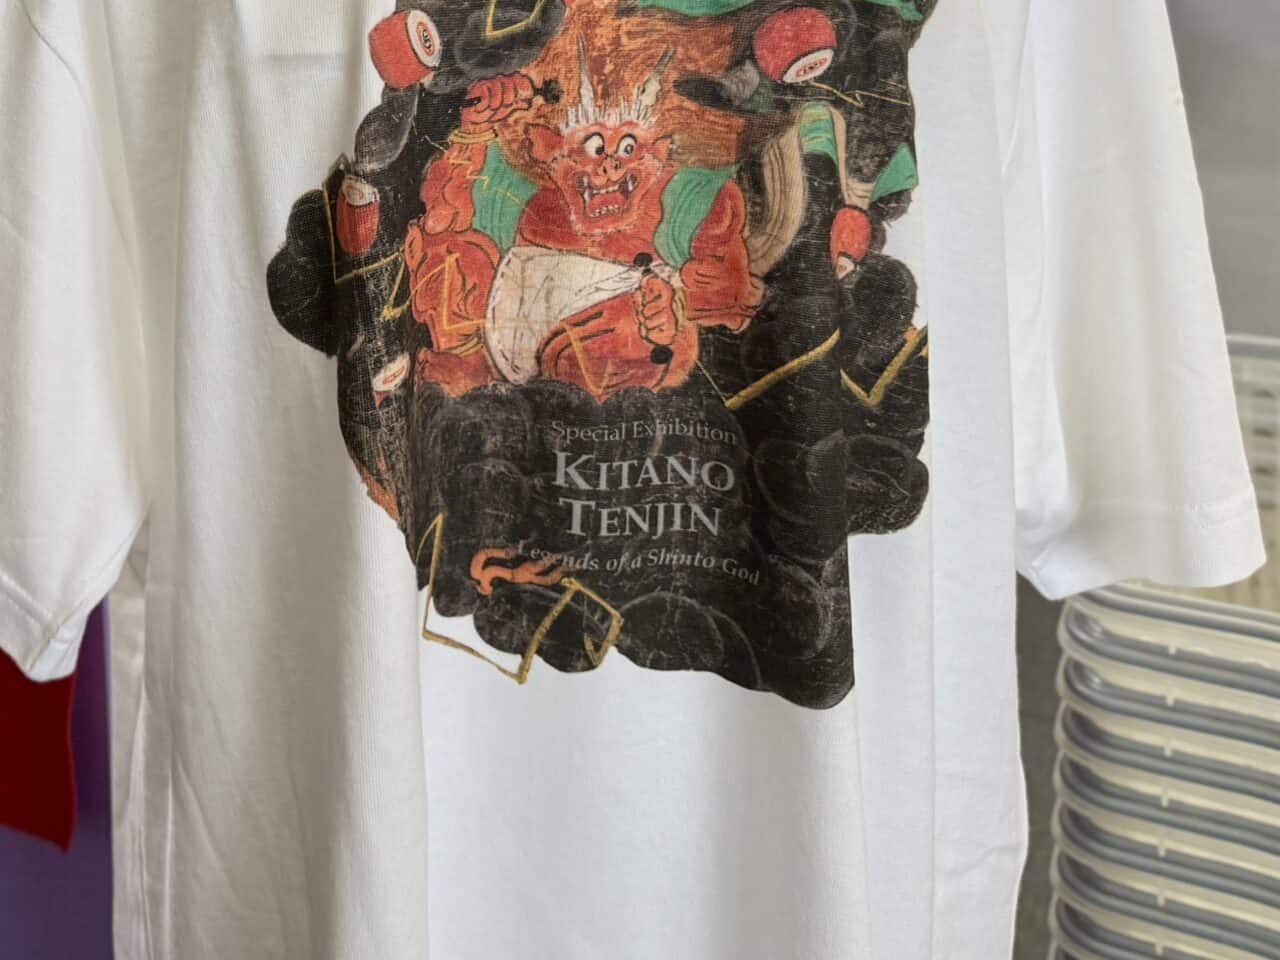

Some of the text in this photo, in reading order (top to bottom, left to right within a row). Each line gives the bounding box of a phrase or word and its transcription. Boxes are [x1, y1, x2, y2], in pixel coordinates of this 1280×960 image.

[551, 419, 737, 446] Special Exhibition
[551, 449, 735, 491] KITANO
[559, 497, 721, 540] TENJIN
[605, 552, 629, 576] of
[631, 556, 643, 570] a
[647, 547, 716, 570] Shinto
[721, 557, 761, 586] God
